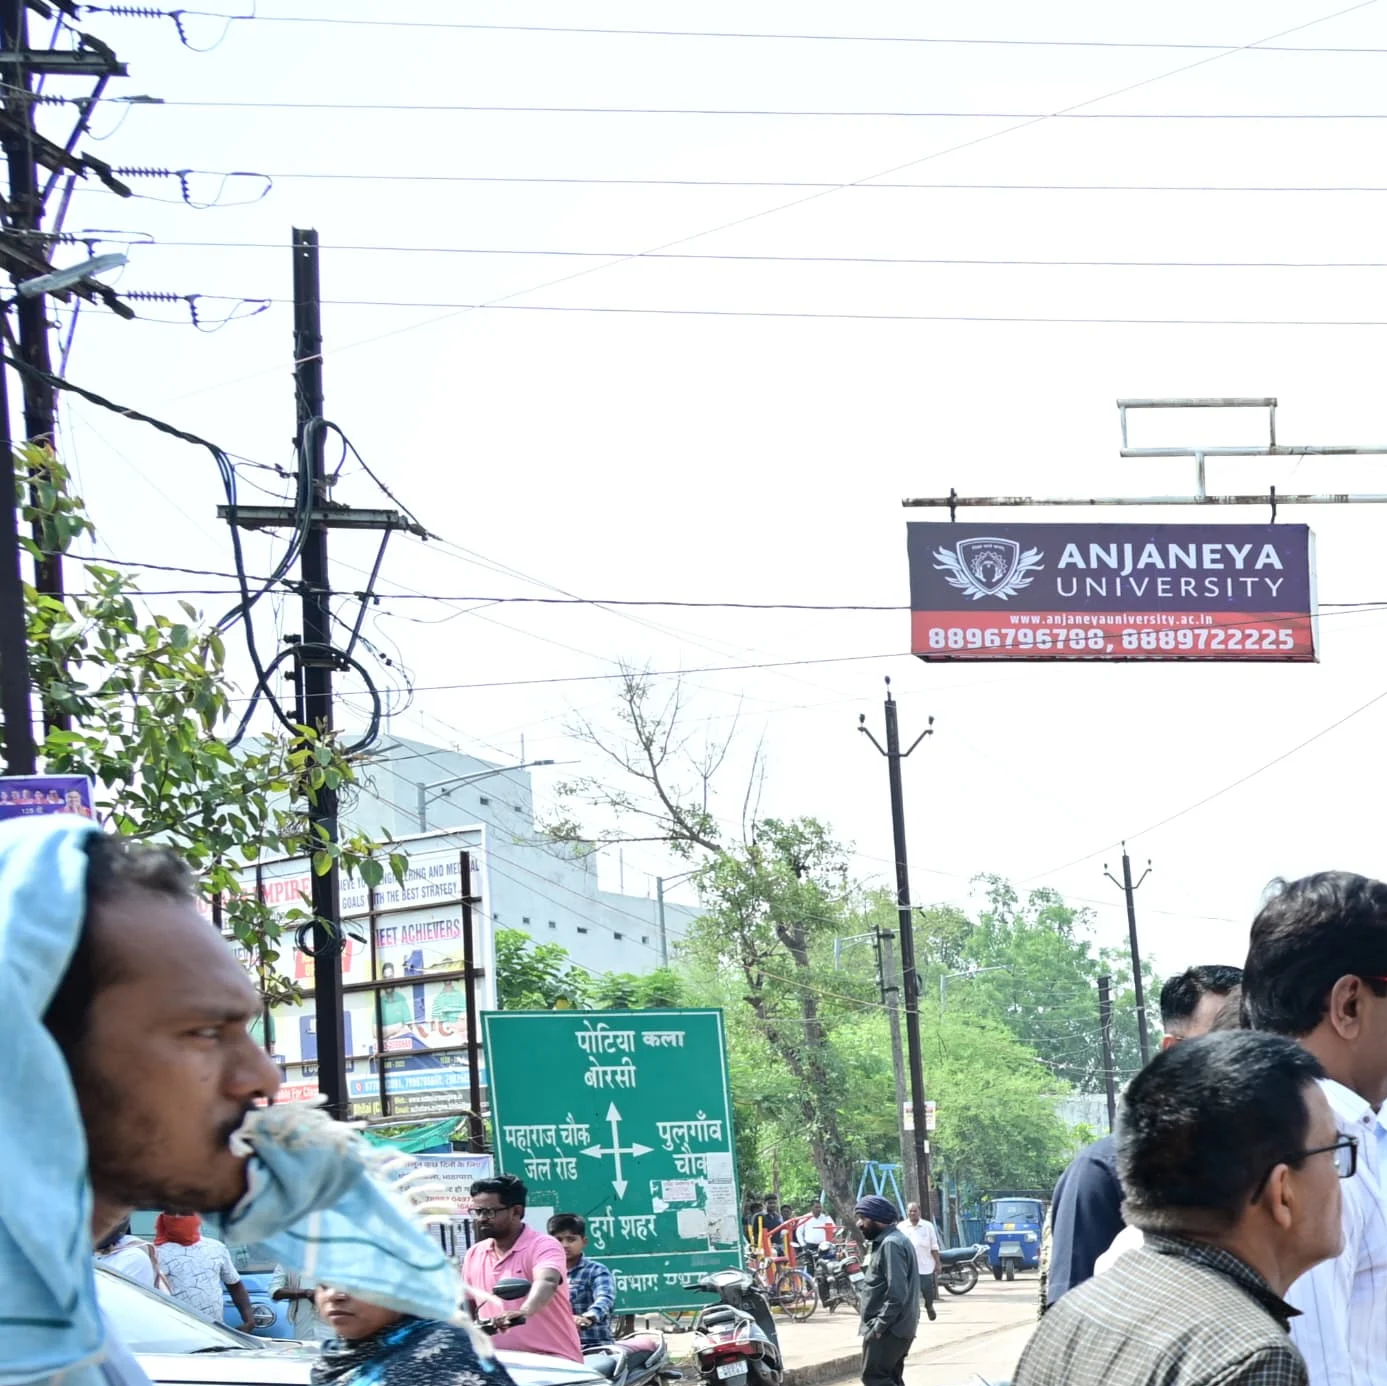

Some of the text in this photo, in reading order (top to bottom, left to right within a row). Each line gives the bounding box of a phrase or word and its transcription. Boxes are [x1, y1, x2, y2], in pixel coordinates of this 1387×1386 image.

[1057, 543, 1283, 576] ANJANEYA
[1057, 577, 1283, 597] UNIVERSITY
[1010, 613, 1212, 626] www.anjaneyauniversity.ac.in
[928, 628, 1294, 653] 8896796788, 8889722225
[429, 865, 444, 878] AND
[343, 896, 365, 909] GOALS
[387, 890, 400, 902] THE
[402, 887, 419, 901] BEST
[421, 882, 457, 898] STRATEGY
[401, 918, 461, 946] ACHIEVERS
[575, 1019, 686, 1053] पोटिया कला
[584, 1055, 637, 1089] बोरसी
[503, 1112, 591, 1149] महाराज चौक
[523, 1148, 578, 1181] जेल रोड
[588, 1205, 657, 1249] दुर्ग शहर
